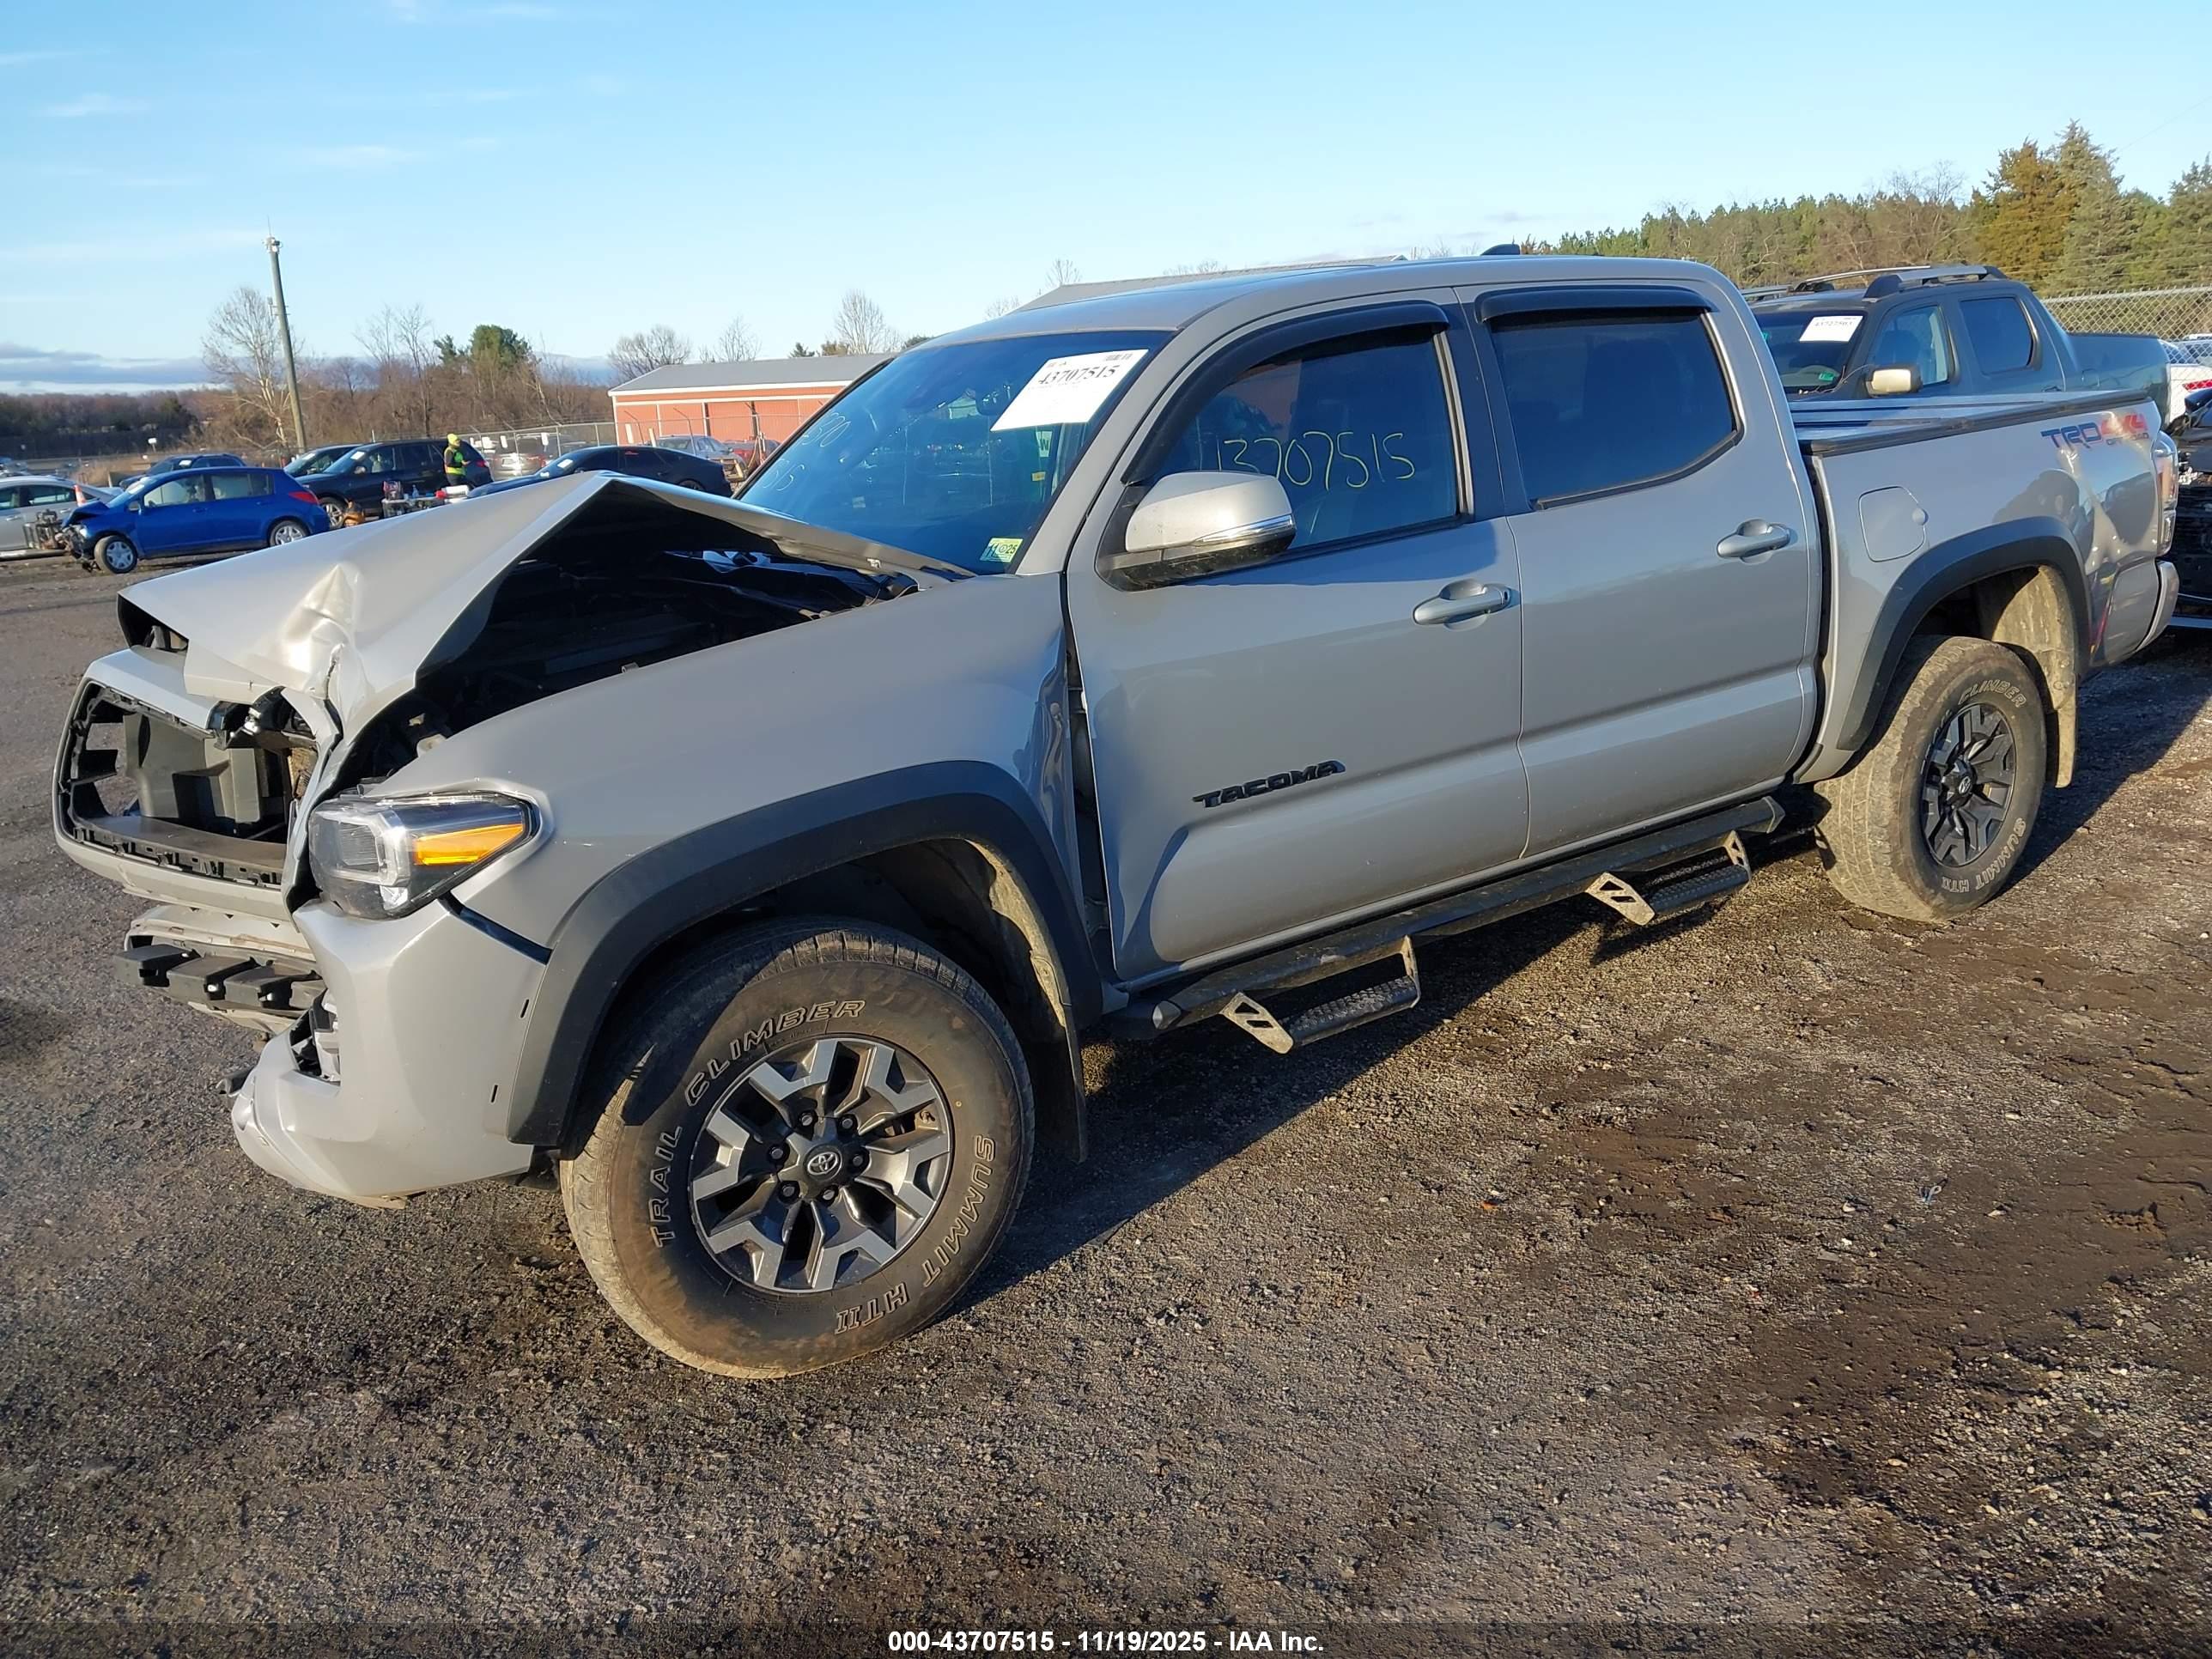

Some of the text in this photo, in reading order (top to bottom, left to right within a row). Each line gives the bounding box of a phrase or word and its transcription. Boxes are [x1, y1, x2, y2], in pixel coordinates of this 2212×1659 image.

[1038, 365, 1120, 384] 43707515
[2040, 422, 2102, 451] TRD
[1192, 759, 1346, 809] TACOMA
[648, 1000, 866, 1248] TRAIL CLIMBER
[922, 1134, 995, 1287] SUMMIT
